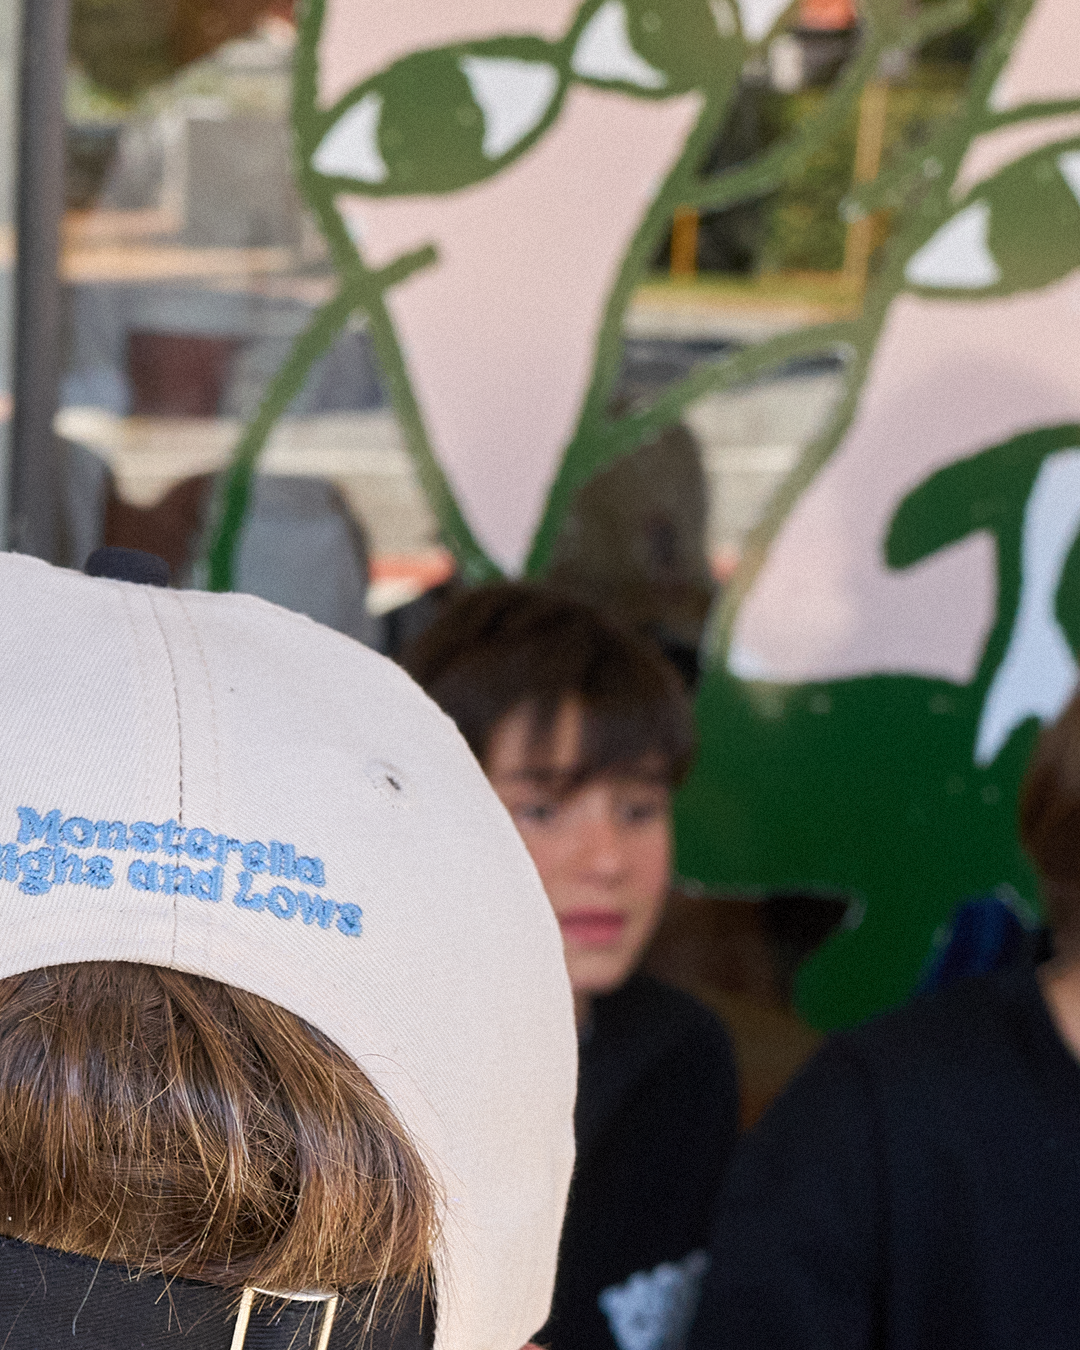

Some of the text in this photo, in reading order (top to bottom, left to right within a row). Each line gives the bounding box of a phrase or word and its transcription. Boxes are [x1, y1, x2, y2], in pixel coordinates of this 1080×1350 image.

[16, 805, 326, 888] Monsterella
[127, 858, 226, 903] and
[232, 870, 363, 937] Lows
